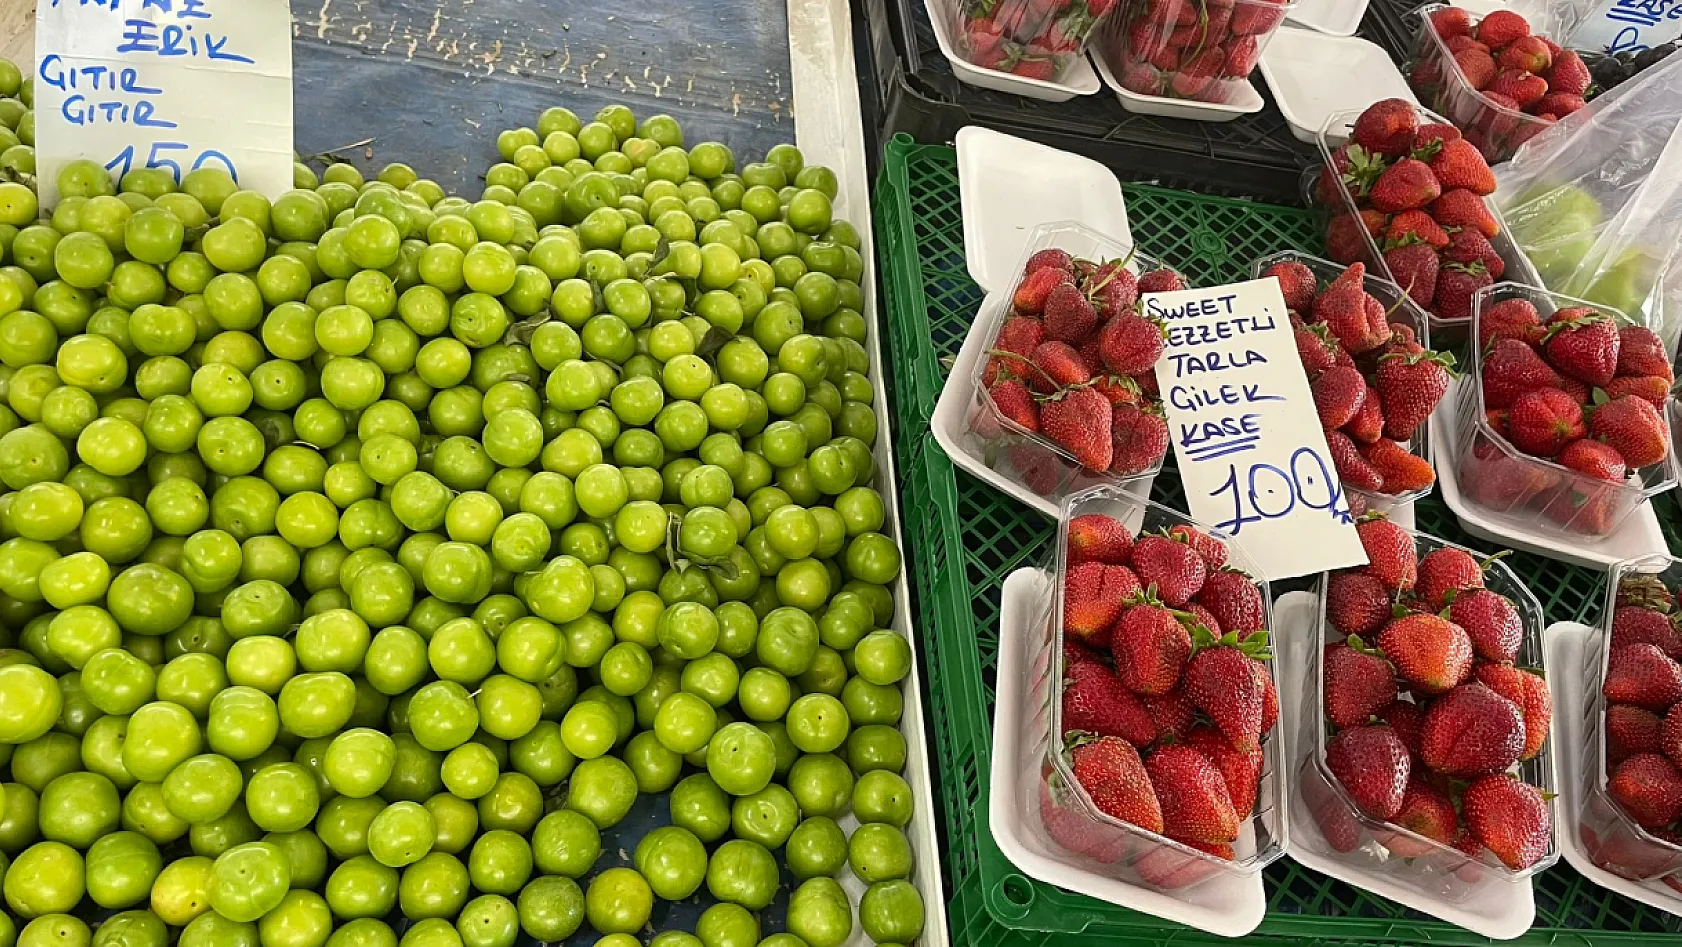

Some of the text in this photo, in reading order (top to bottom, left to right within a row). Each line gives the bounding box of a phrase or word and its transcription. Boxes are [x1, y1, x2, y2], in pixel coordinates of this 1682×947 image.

[1147, 294, 1237, 320] SWEET
[1167, 349, 1268, 378] TARLA
[1180, 413, 1263, 447] KASE
